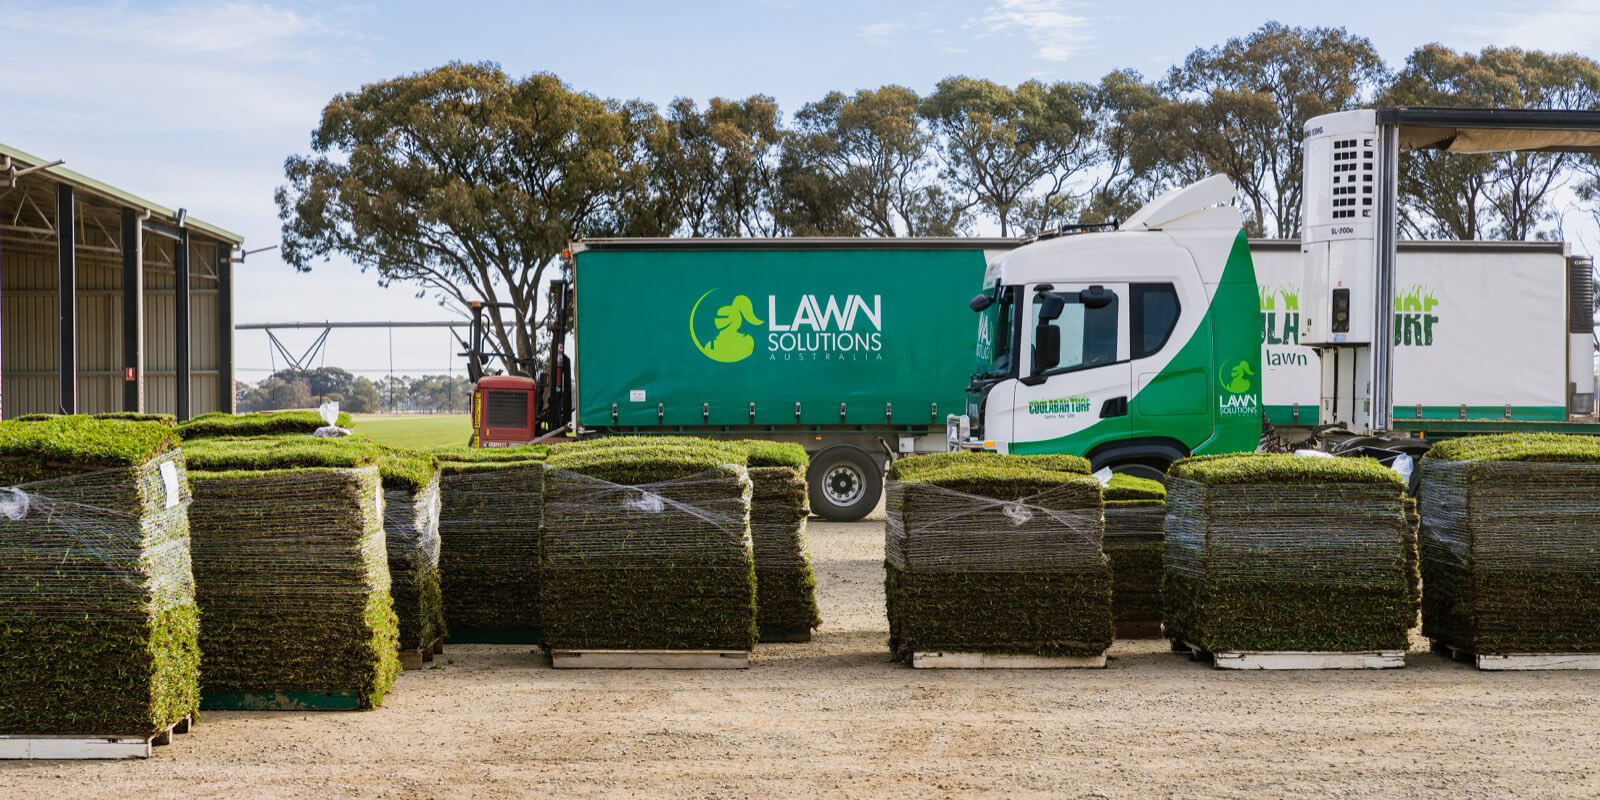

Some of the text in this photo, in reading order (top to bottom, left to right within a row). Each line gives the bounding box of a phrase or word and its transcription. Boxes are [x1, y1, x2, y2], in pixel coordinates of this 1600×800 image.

[768, 294, 882, 331] LAWN
[768, 332, 882, 351] SOLUTIONS
[769, 353, 882, 361] AUSTRALIA
[1266, 349, 1307, 366] lawn
[1219, 394, 1257, 408] LAWN
